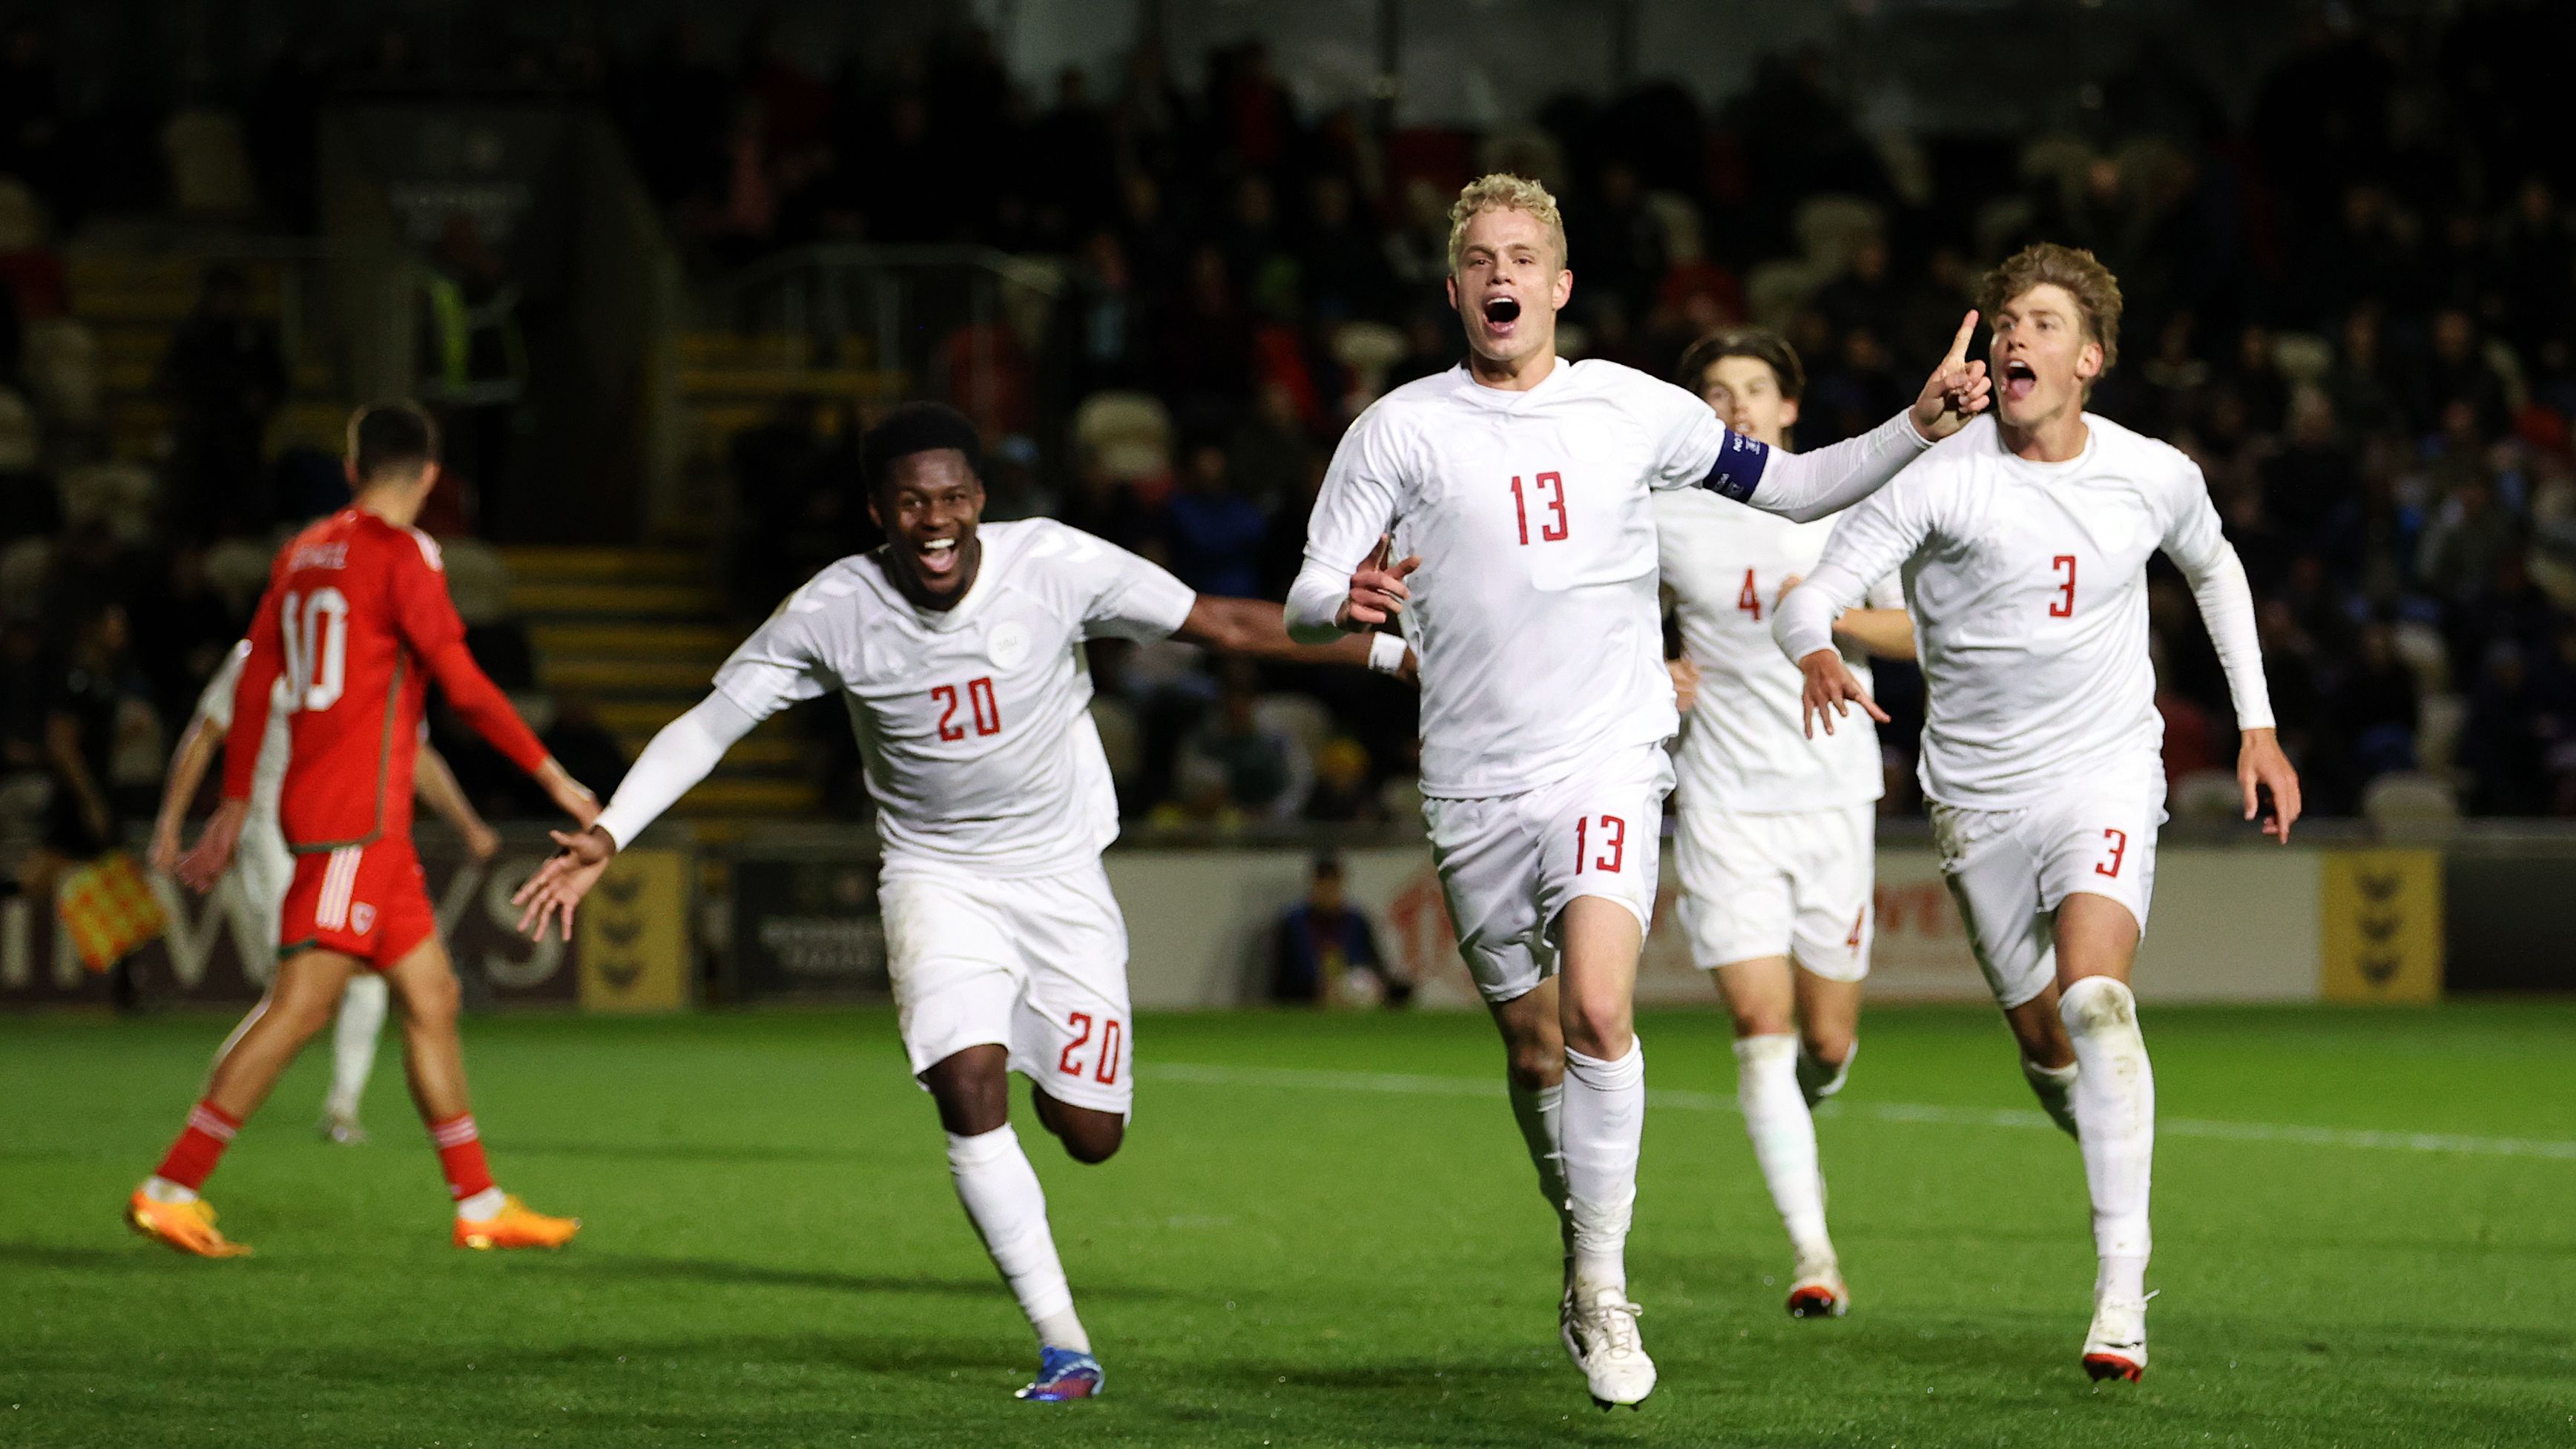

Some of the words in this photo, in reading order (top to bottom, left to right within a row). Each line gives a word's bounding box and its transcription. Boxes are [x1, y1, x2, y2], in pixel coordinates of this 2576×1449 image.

[1512, 471, 1569, 546] 13
[1739, 569, 1760, 620] 4
[2049, 555, 2077, 618] 3
[280, 587, 349, 712] 10
[932, 676, 1001, 742] 20
[1574, 814, 1626, 874] 13
[2095, 828, 2127, 879] 3
[1846, 904, 1865, 955] 4
[1058, 1011, 1121, 1086] 20
